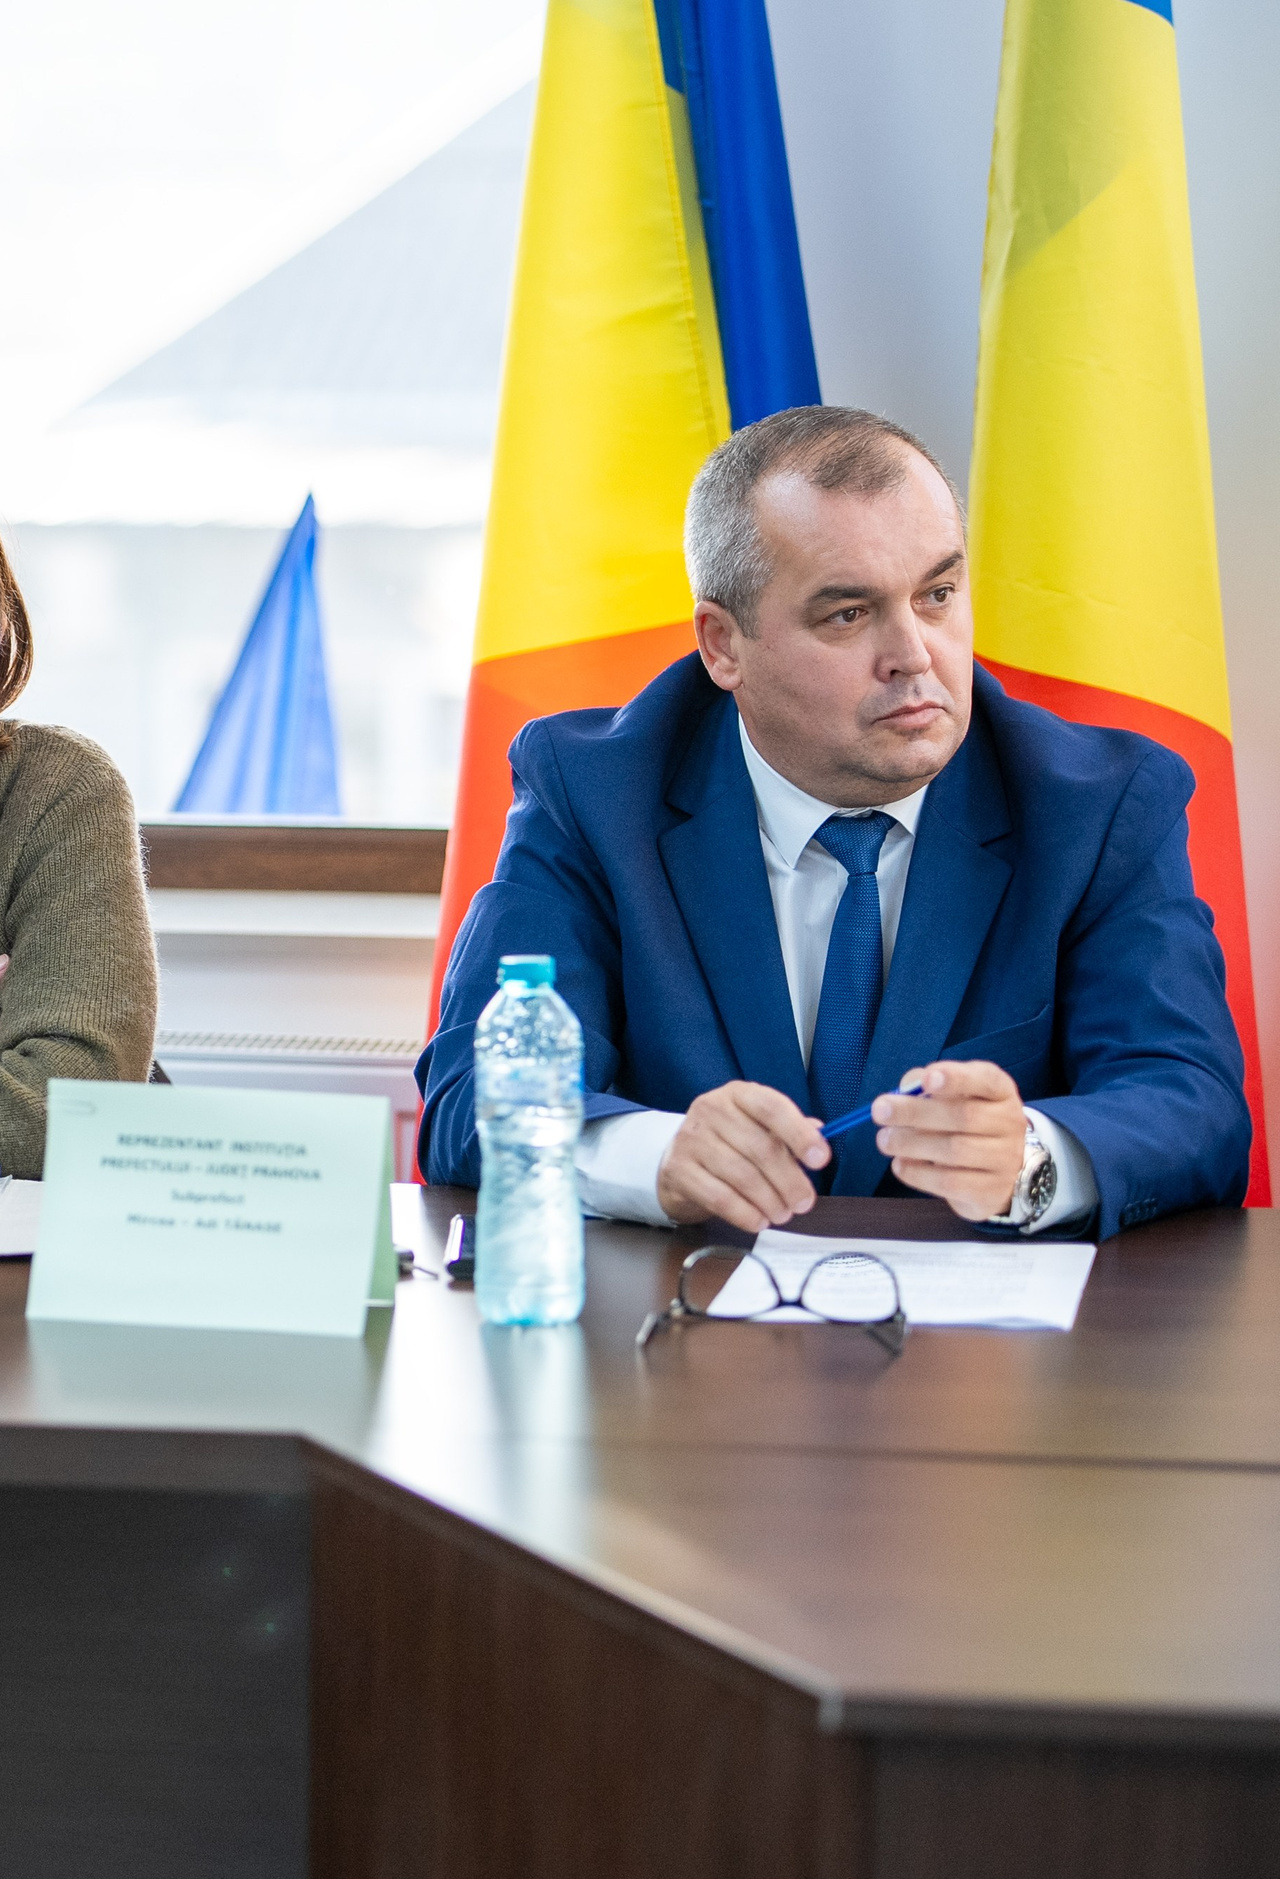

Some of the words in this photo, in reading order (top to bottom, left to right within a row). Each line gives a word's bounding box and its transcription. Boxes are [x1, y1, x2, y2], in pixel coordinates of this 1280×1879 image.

[117, 1133, 223, 1151] REPREZENTANT
[101, 1156, 190, 1174] PREFECTULUI
[253, 1165, 322, 1181] PRAHOVA
[170, 1188, 245, 1204] Subprefect
